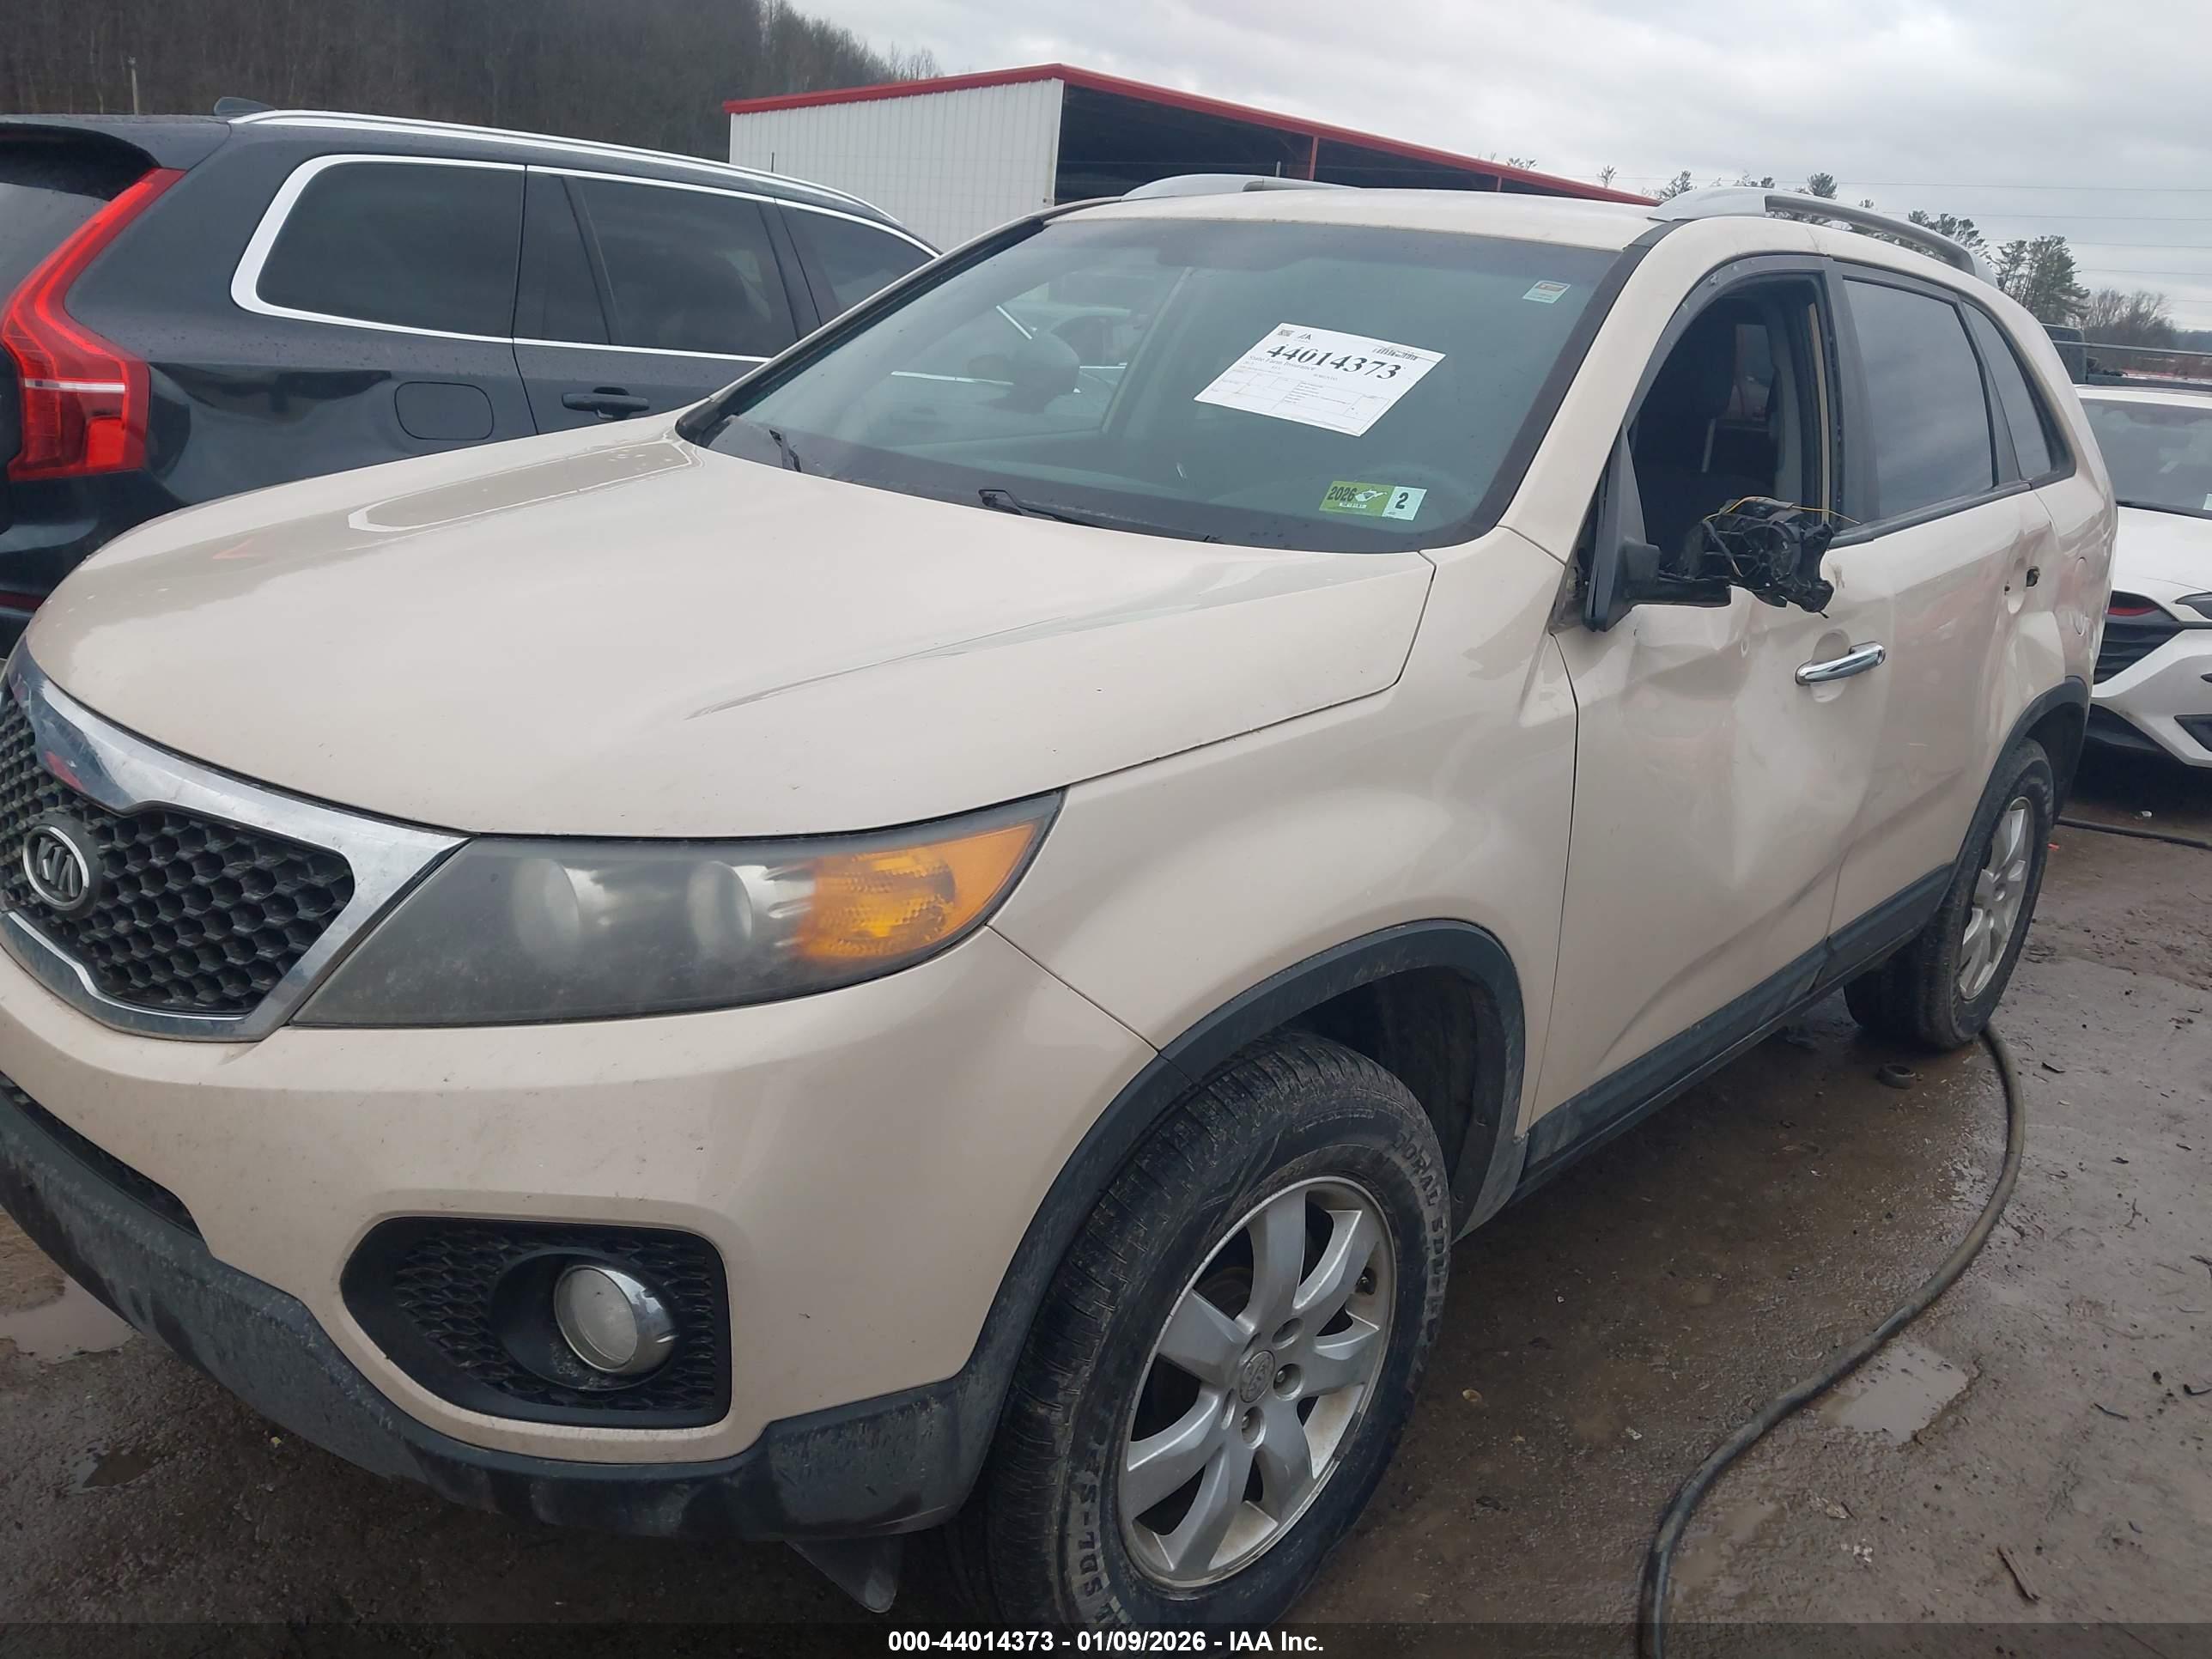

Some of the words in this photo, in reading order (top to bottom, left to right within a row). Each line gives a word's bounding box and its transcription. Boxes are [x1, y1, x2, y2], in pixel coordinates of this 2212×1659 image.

[1265, 343, 1402, 380] 44014373
[1327, 486, 1358, 502] 2026
[1395, 492, 1409, 509] 2
